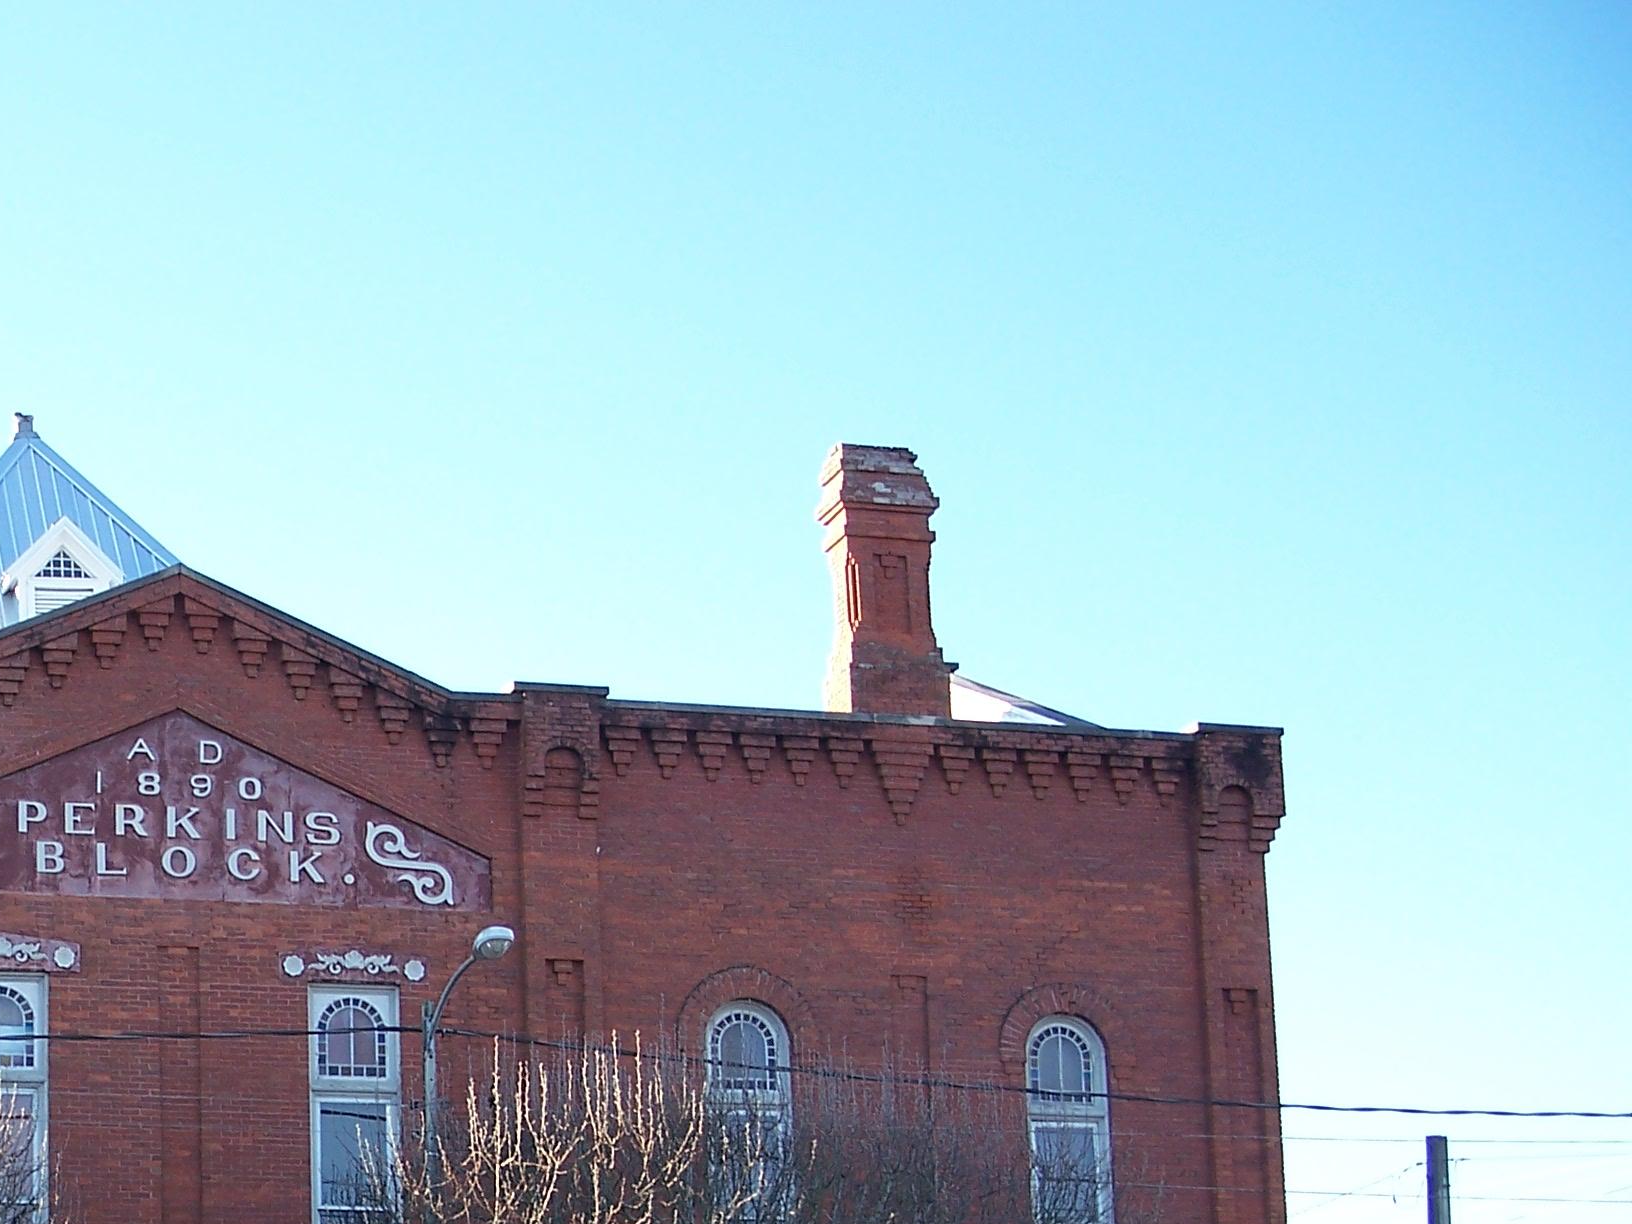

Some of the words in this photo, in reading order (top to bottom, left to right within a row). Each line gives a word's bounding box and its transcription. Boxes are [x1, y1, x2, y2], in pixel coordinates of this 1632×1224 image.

[126, 737, 156, 761] A
[199, 739, 222, 764] D
[96, 770, 262, 800] 1890
[18, 800, 341, 844] PERKINS
[36, 841, 355, 885] BLOCK.
